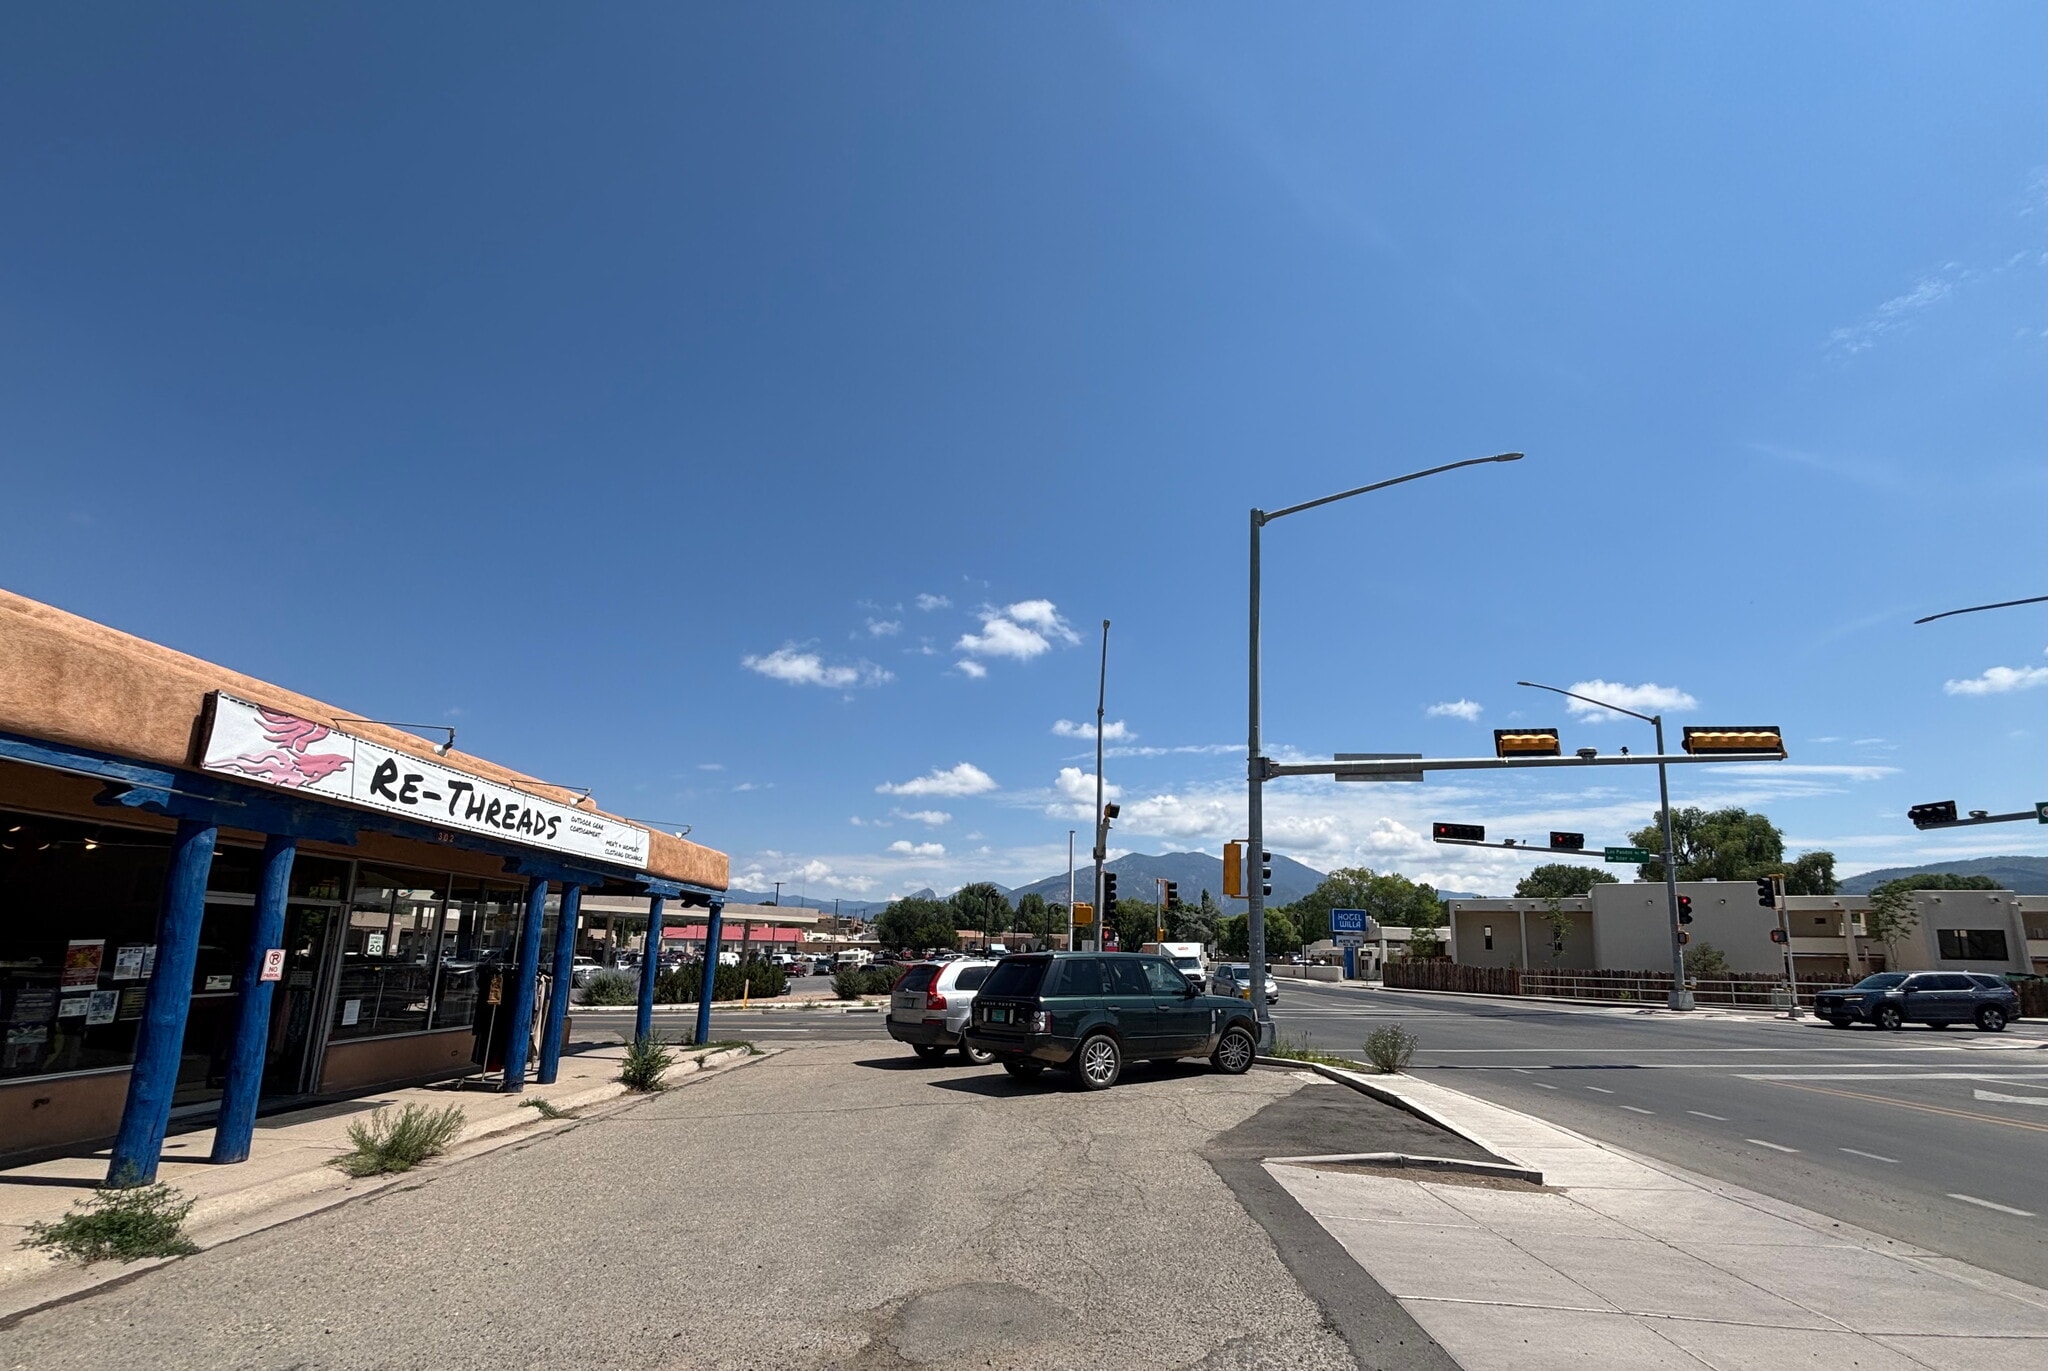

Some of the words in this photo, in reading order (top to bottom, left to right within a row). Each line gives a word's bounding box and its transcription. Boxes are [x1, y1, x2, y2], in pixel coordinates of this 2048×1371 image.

[370, 757, 562, 840] RE-THREADS
[571, 816, 591, 827] OUTDOOR
[592, 822, 604, 830] GEAR
[437, 832, 455, 843] 302
[605, 849, 624, 858] CLOTHING
[625, 852, 643, 861] EXCHANGE
[1338, 913, 1362, 921] HOTEL
[368, 944, 382, 953] 20
